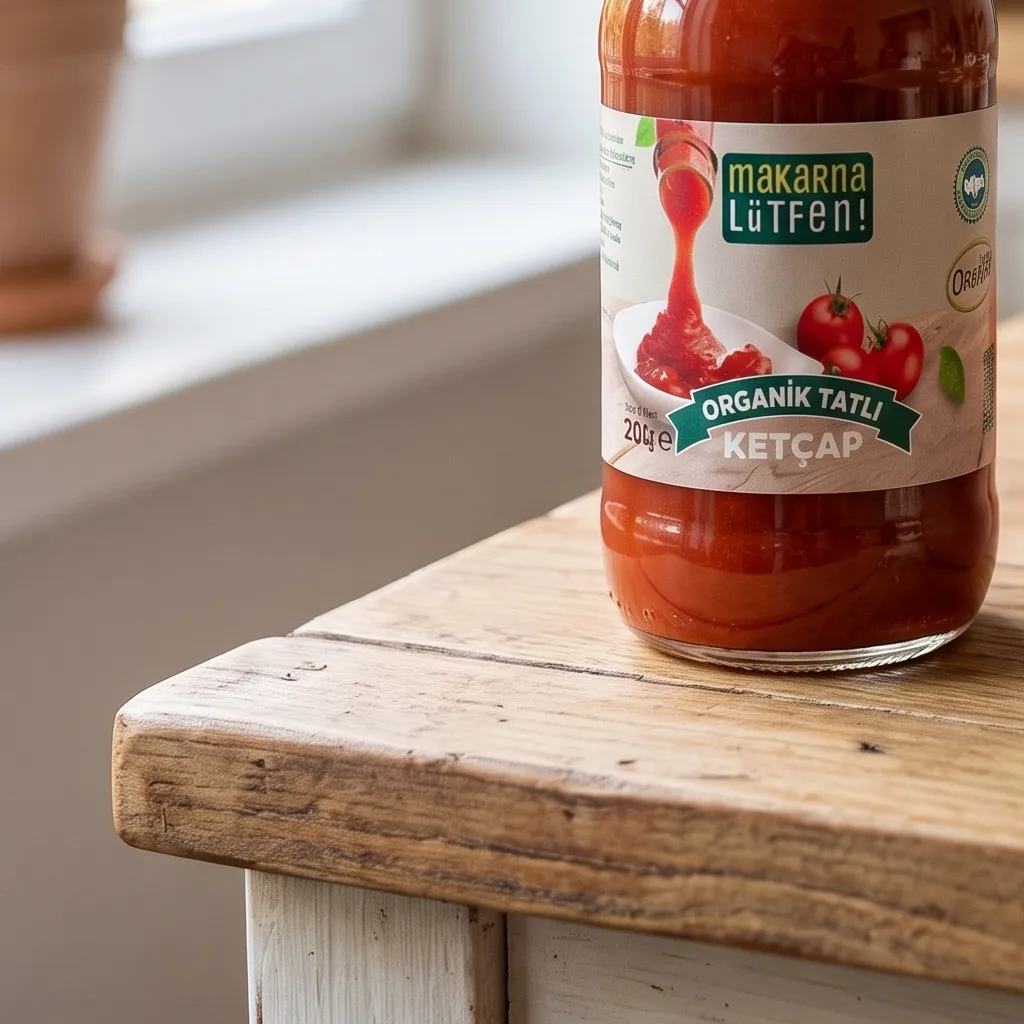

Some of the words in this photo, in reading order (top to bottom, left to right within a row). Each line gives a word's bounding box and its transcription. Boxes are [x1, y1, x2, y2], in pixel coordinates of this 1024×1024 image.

[702, 379, 813, 421] ORGANİK
[818, 387, 884, 422] TATLI
[724, 430, 864, 468] KETÇAP
